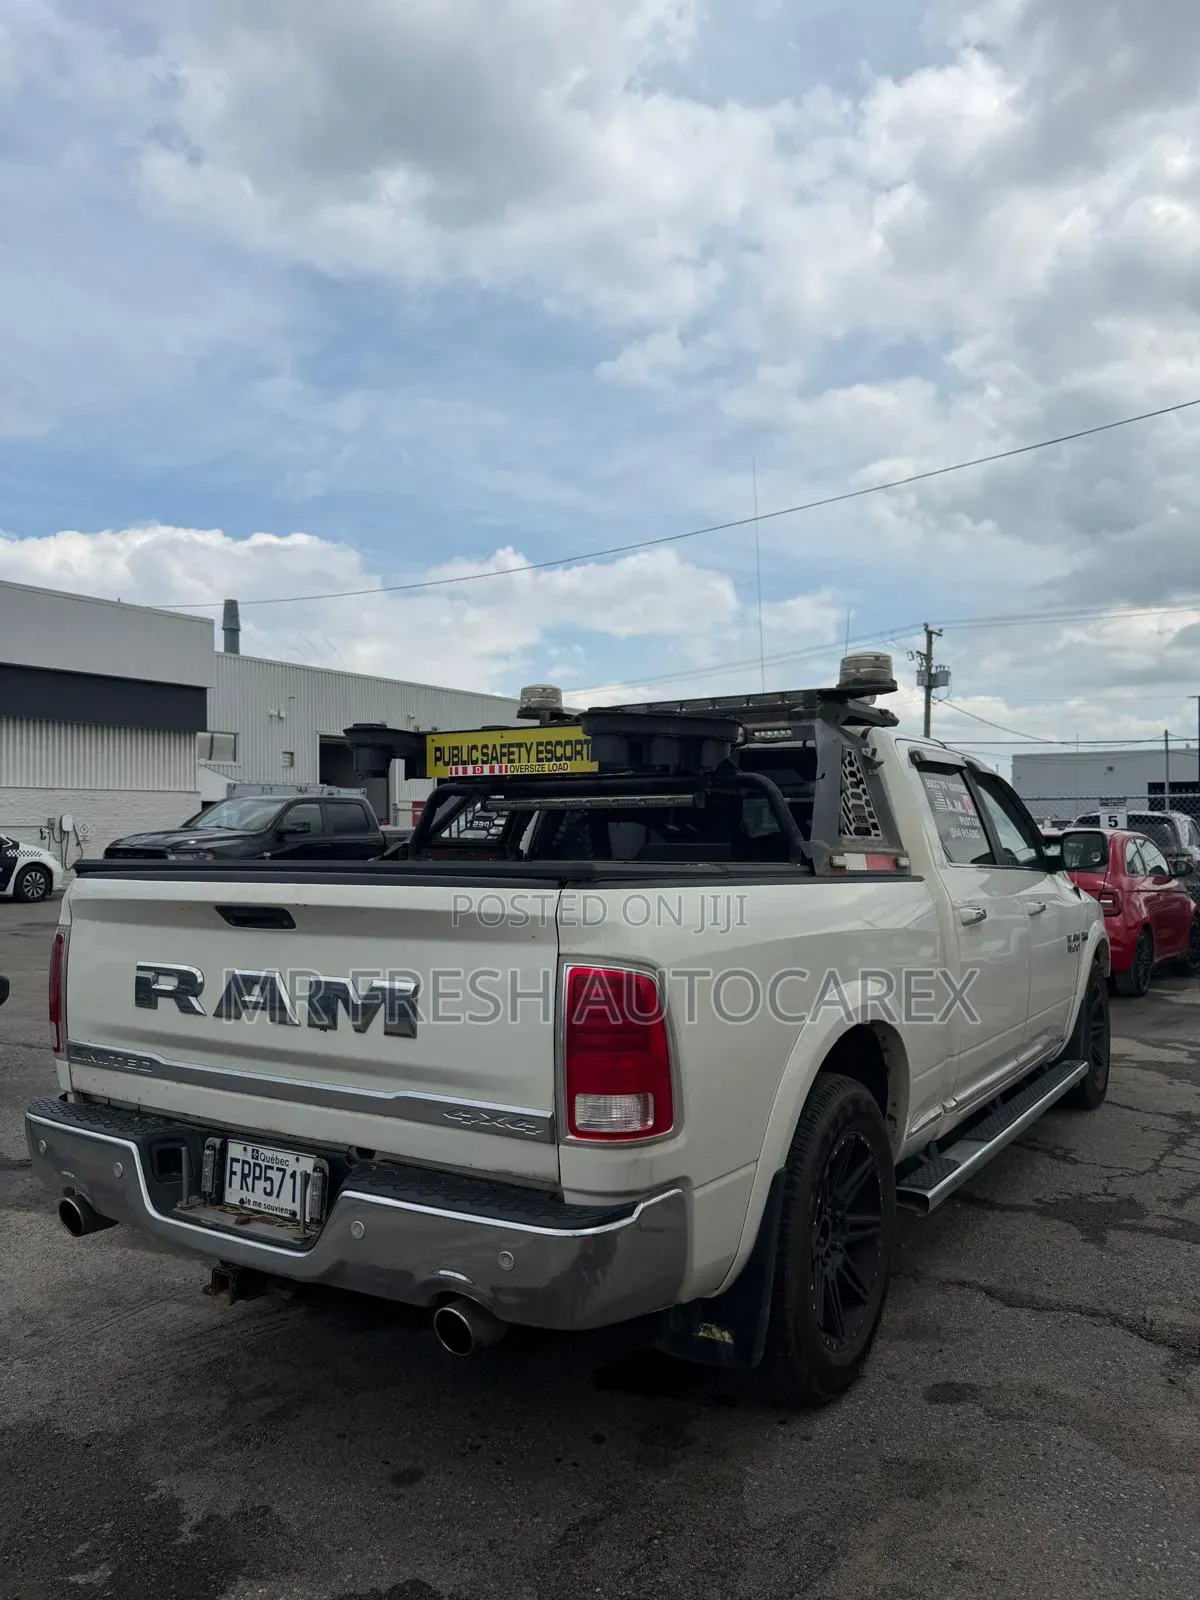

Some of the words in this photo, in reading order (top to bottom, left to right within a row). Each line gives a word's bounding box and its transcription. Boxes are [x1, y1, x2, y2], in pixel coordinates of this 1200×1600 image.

[434, 744, 478, 766] PUBLIC
[480, 742, 533, 764] SAFETY
[536, 739, 592, 763] ESCORT
[509, 763, 546, 773] OVERSIZE
[547, 762, 569, 772] LOAD
[1108, 815, 1119, 828] 5
[134, 960, 420, 1039] RAM
[260, 1152, 290, 1167] Québec
[252, 1200, 262, 1208] me
